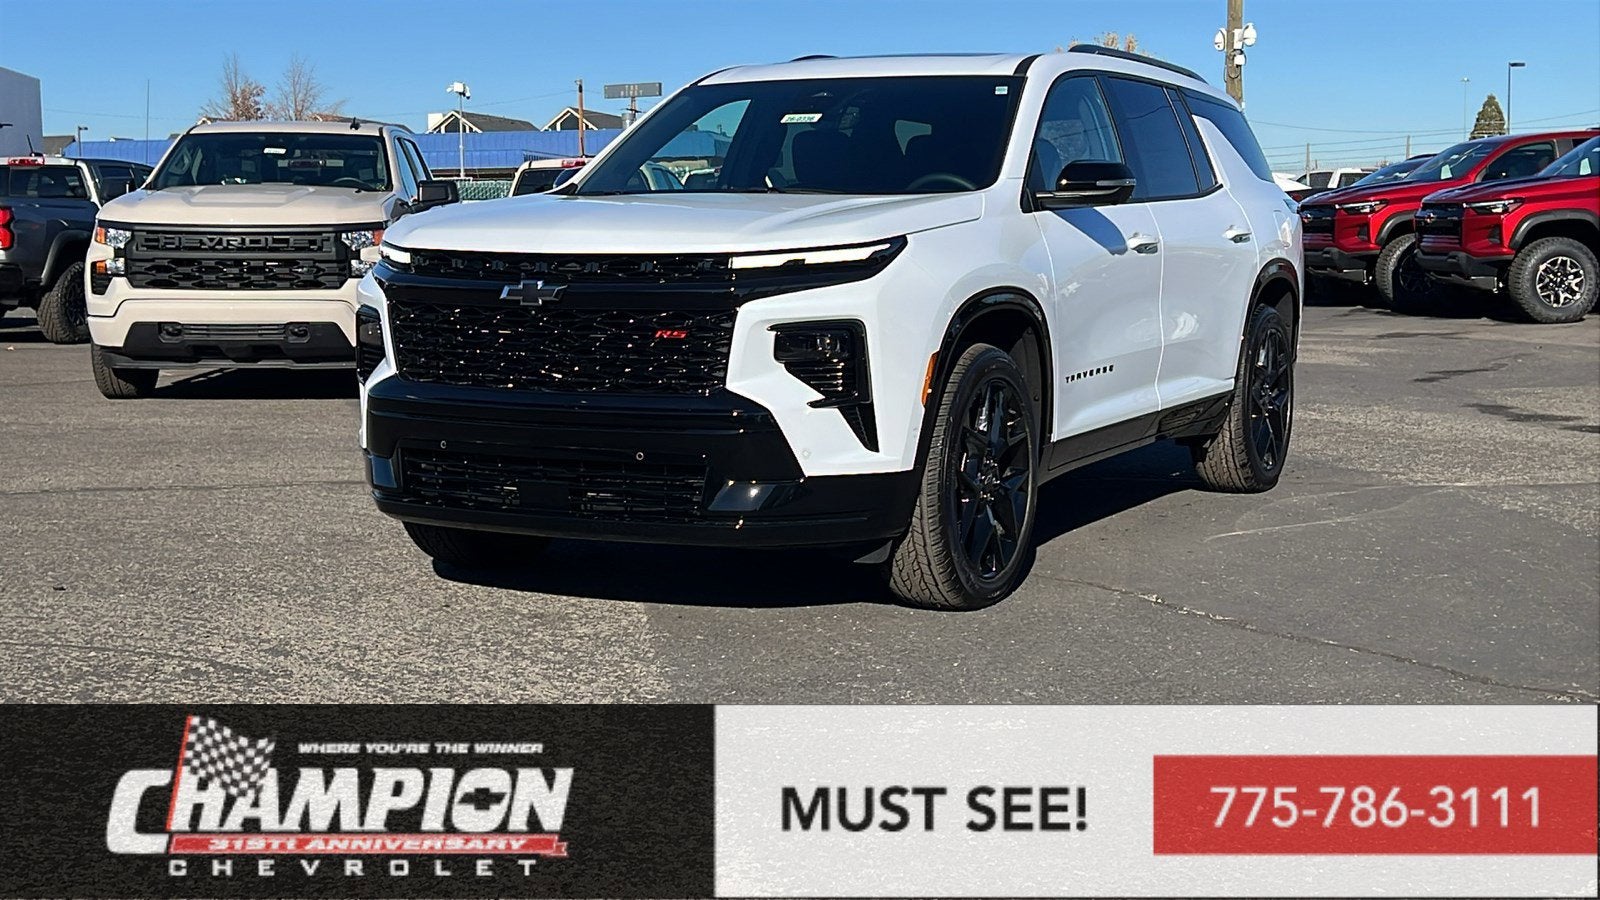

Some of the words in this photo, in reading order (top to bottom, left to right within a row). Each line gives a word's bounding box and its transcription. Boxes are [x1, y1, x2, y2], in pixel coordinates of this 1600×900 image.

[140, 234, 329, 250] CHEVROLET
[655, 330, 688, 339] RS
[1065, 364, 1114, 383] TRAVERSE
